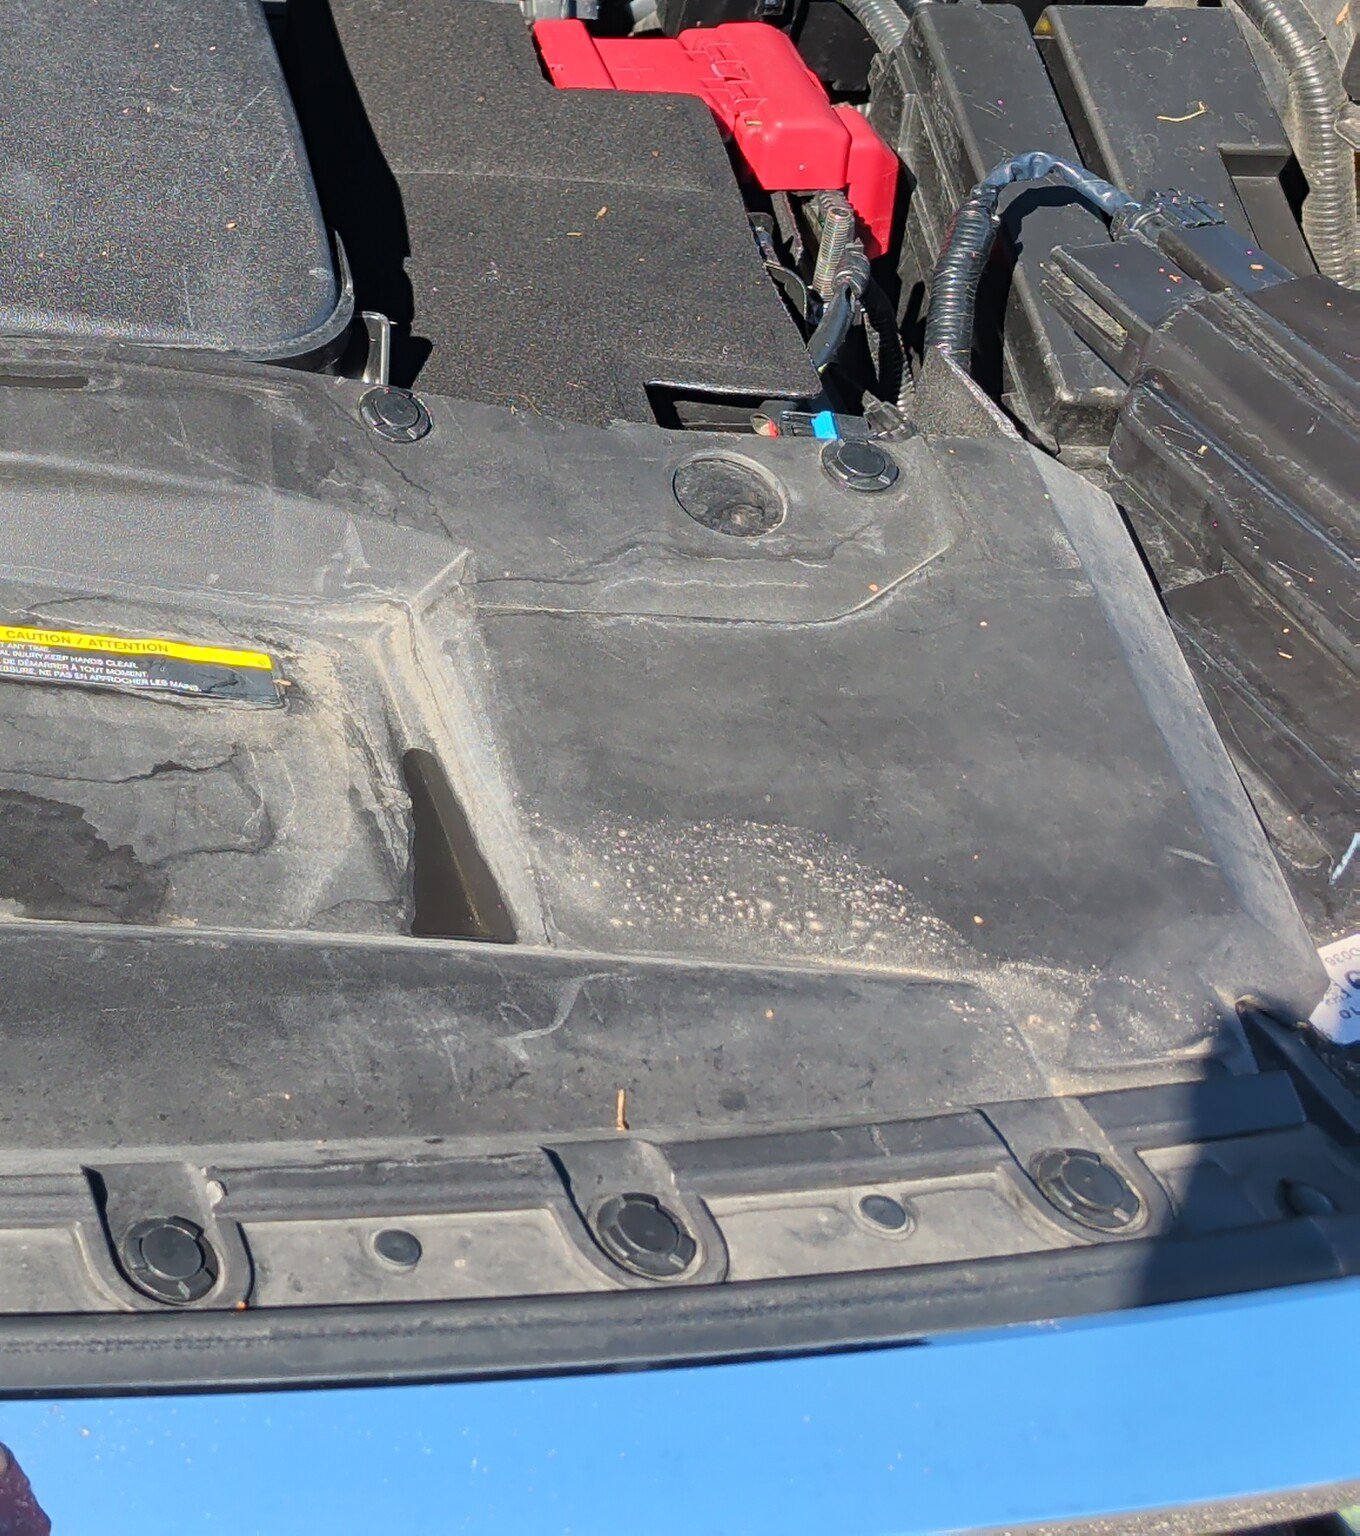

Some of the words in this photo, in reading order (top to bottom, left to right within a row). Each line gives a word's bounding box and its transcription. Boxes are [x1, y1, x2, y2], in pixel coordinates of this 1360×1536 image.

[5, 630, 71, 645] CAUTION
[88, 638, 169, 652] ATTENTION
[7, 642, 26, 650] ANY
[18, 658, 69, 672] DÉMARRER
[80, 665, 104, 674] TOUT
[70, 656, 104, 666] HANDS
[38, 669, 52, 677] NE
[54, 671, 73, 679] PAS
[74, 672, 88, 680] EN
[90, 673, 149, 685] APPROCHER
[150, 679, 168, 687] LES
